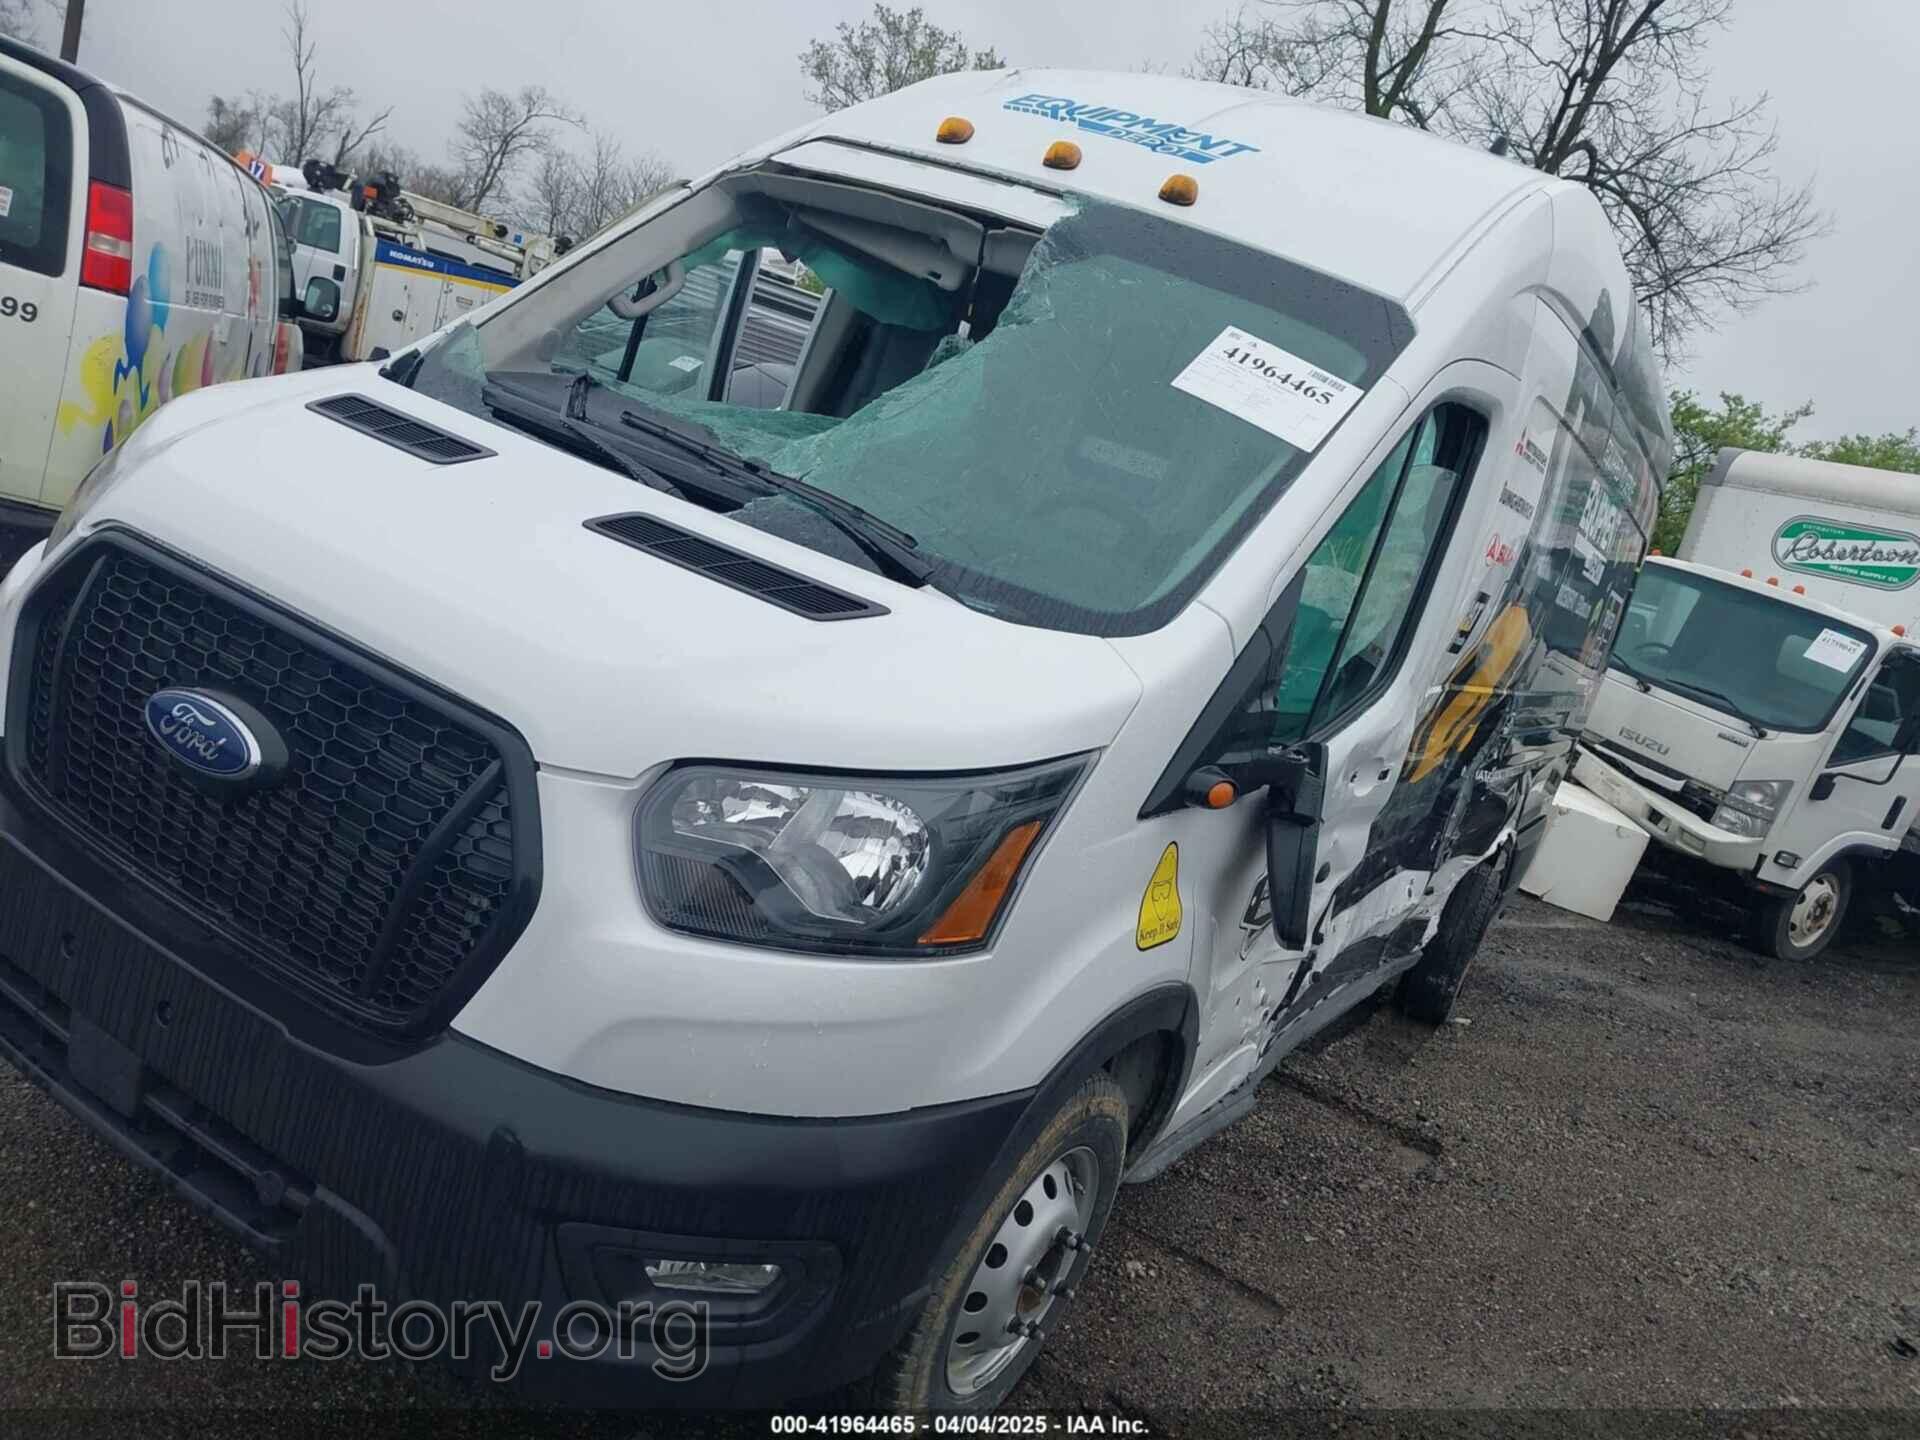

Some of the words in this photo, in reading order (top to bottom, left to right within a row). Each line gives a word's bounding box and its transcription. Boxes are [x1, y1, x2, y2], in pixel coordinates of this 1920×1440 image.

[1007, 94, 1261, 157] EQUIPMENT
[1106, 128, 1190, 156] DEPOT
[389, 249, 435, 268] KOMATSU
[1223, 346, 1336, 405] 41964465
[1782, 531, 1920, 565] Robertson
[159, 703, 228, 760] Ford
[1618, 726, 1671, 756] ISUZU
